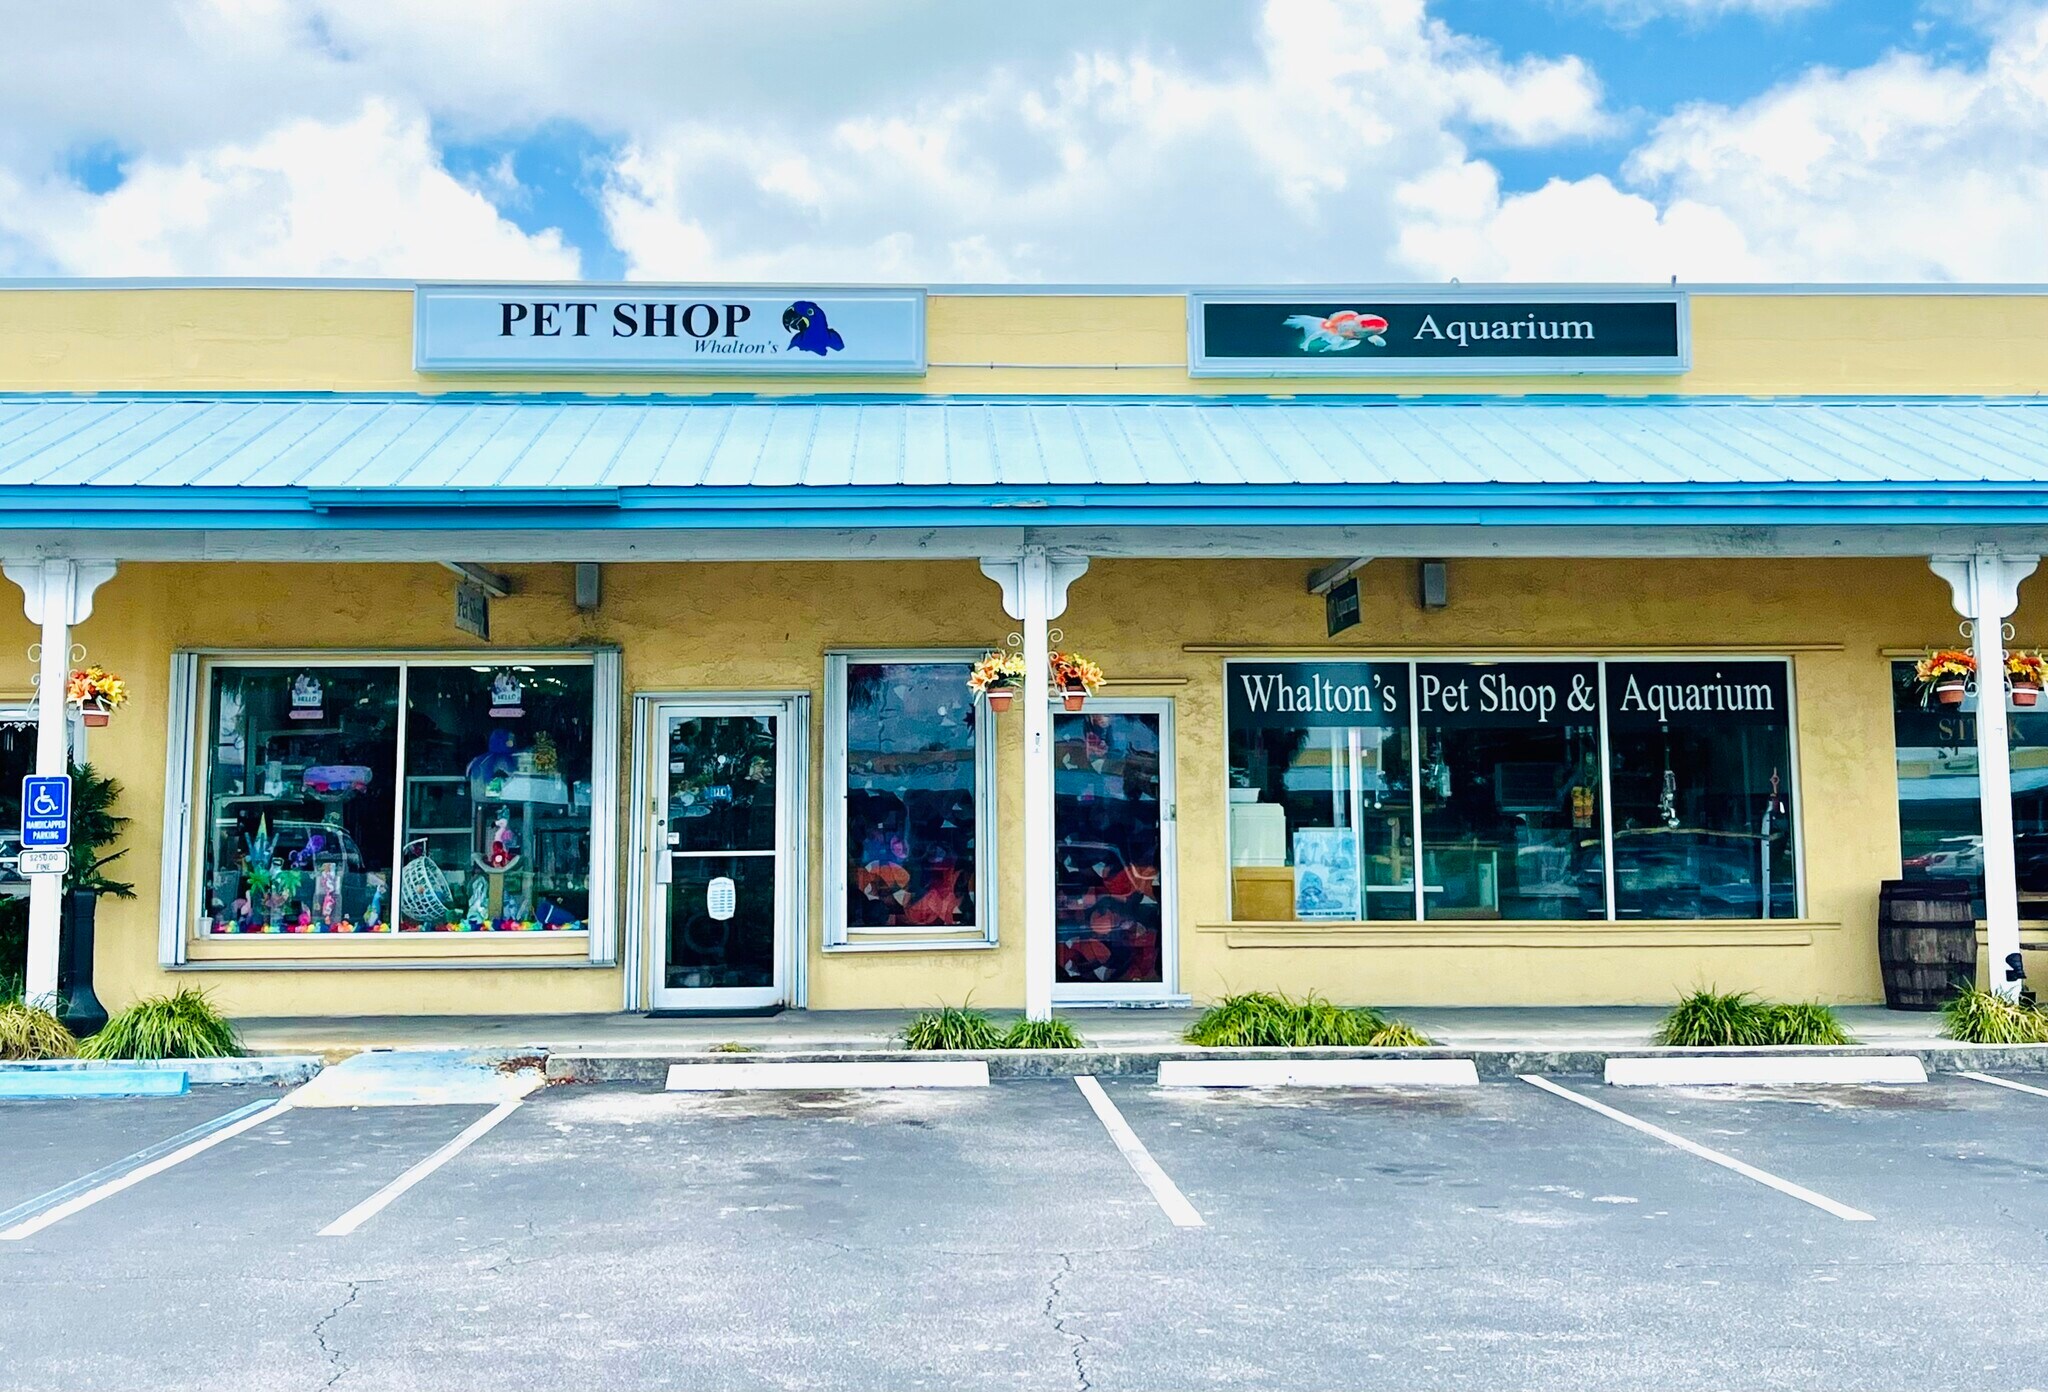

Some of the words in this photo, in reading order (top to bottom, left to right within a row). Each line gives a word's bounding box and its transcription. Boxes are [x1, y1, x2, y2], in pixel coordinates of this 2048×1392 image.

[499, 302, 598, 337] PET
[612, 302, 751, 338] SHOP
[1413, 313, 1595, 347] Aquarium
[694, 338, 779, 355] Whalton's
[1239, 673, 1397, 713] Whalton's
[1420, 674, 1470, 712] Pet
[1478, 673, 1556, 723] Shop
[1566, 673, 1596, 712] &
[1619, 672, 1775, 722] Aquarium
[26, 820, 66, 829] HANDICAPPED
[32, 831, 59, 839] PARKING
[36, 863, 50, 871] FINE
